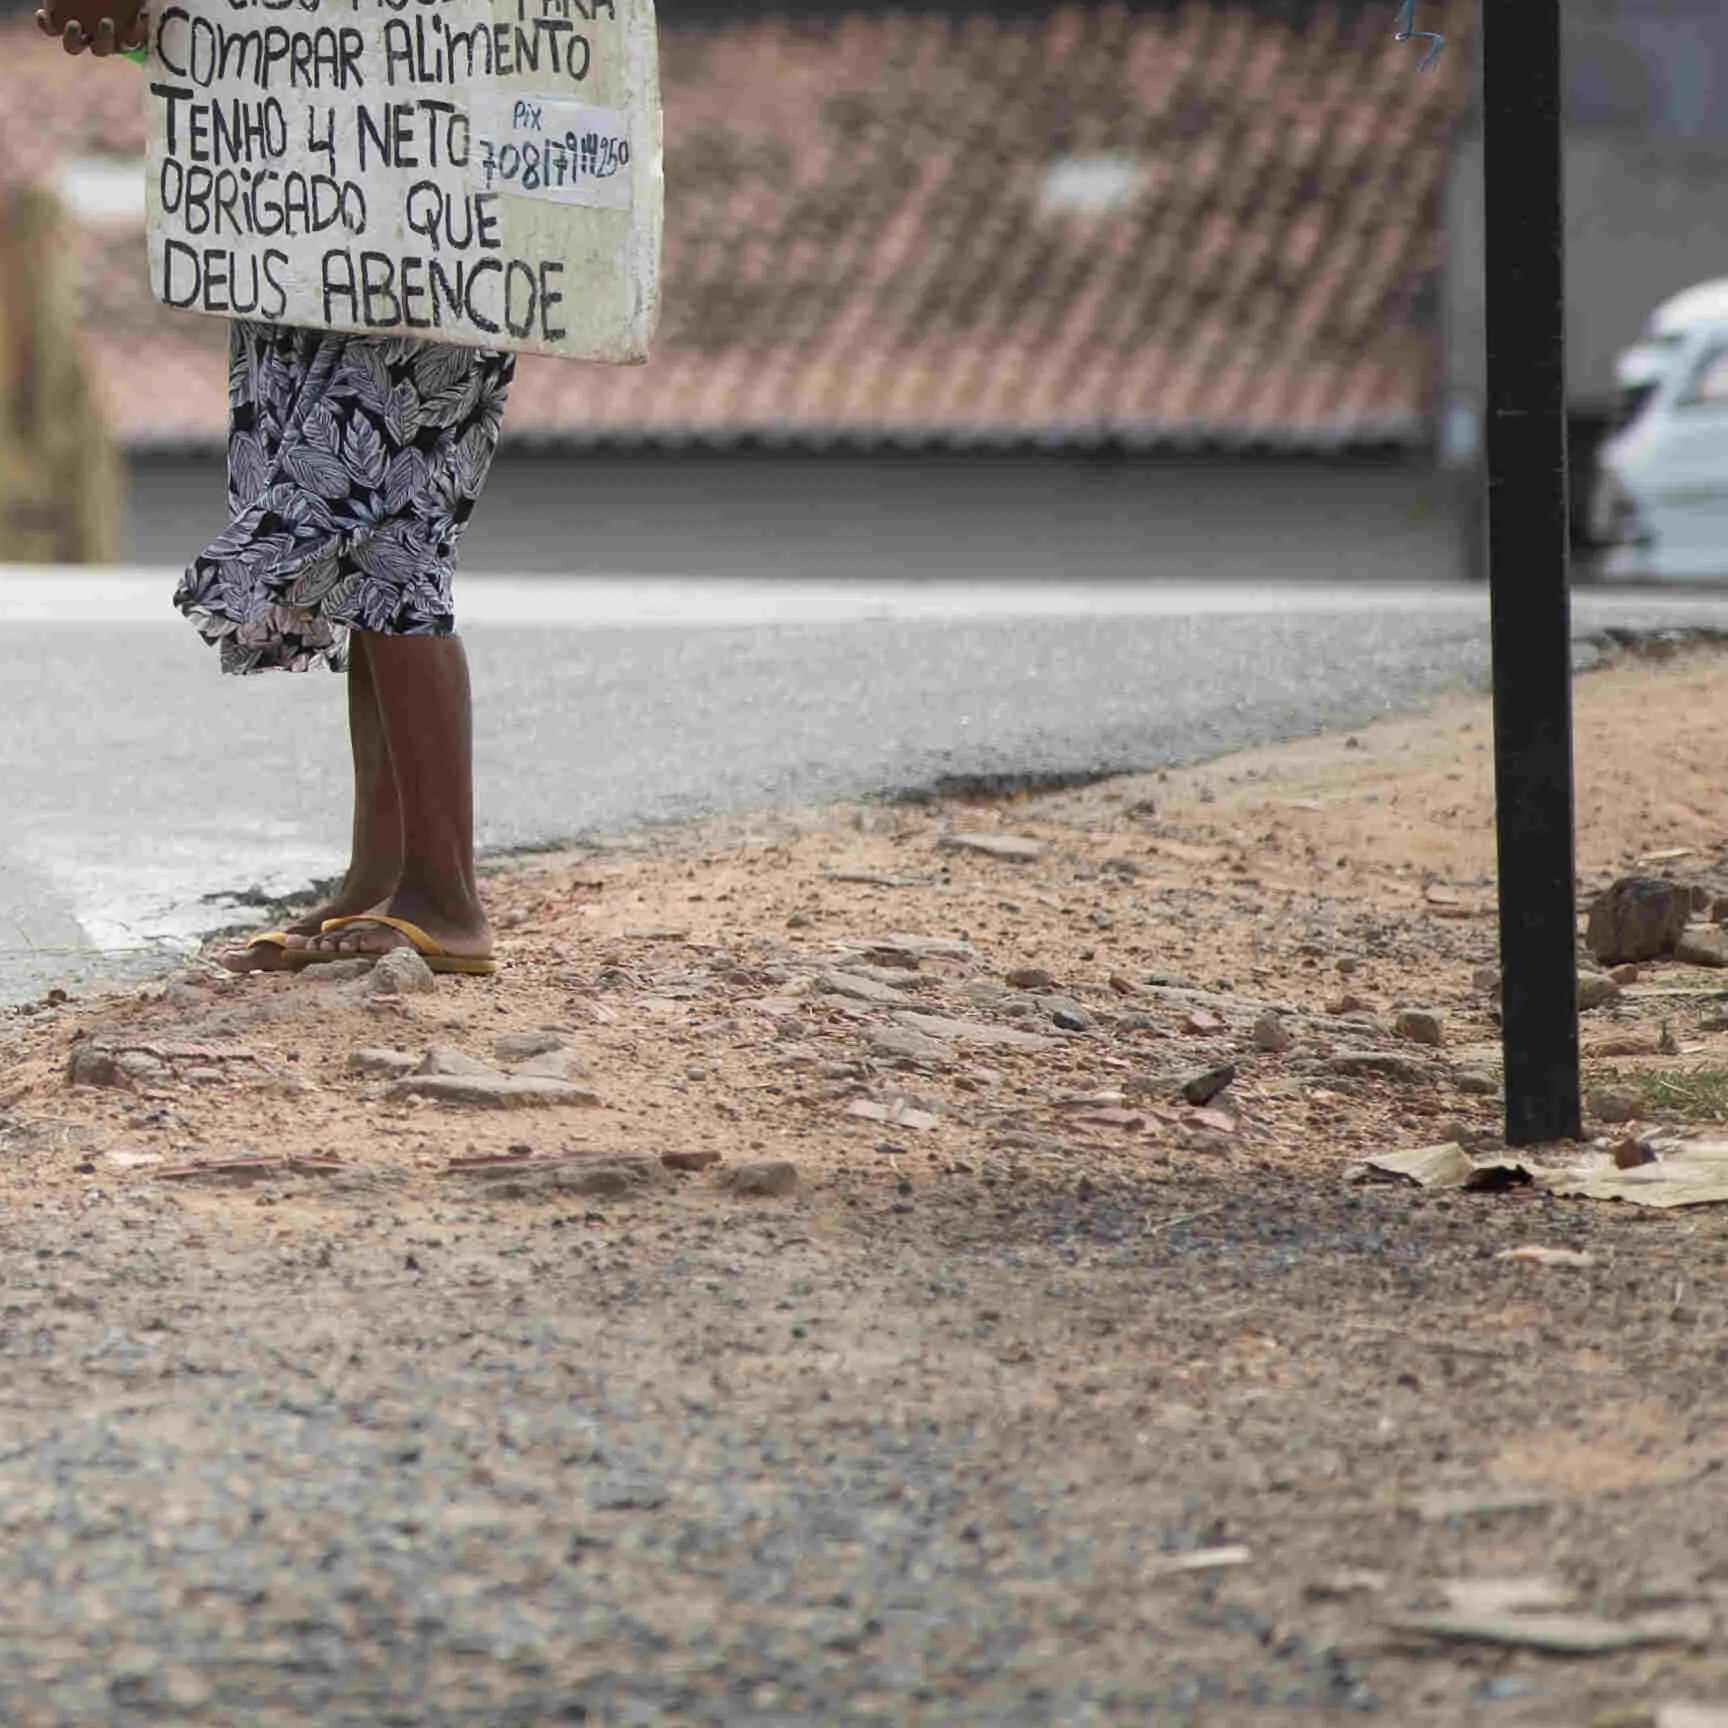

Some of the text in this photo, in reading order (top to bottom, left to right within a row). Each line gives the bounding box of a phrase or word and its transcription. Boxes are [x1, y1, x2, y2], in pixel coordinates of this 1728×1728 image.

[151, 83, 470, 177] TENHO 4 NETO
[406, 181, 501, 250] QUE
[163, 240, 289, 318] DEUS
